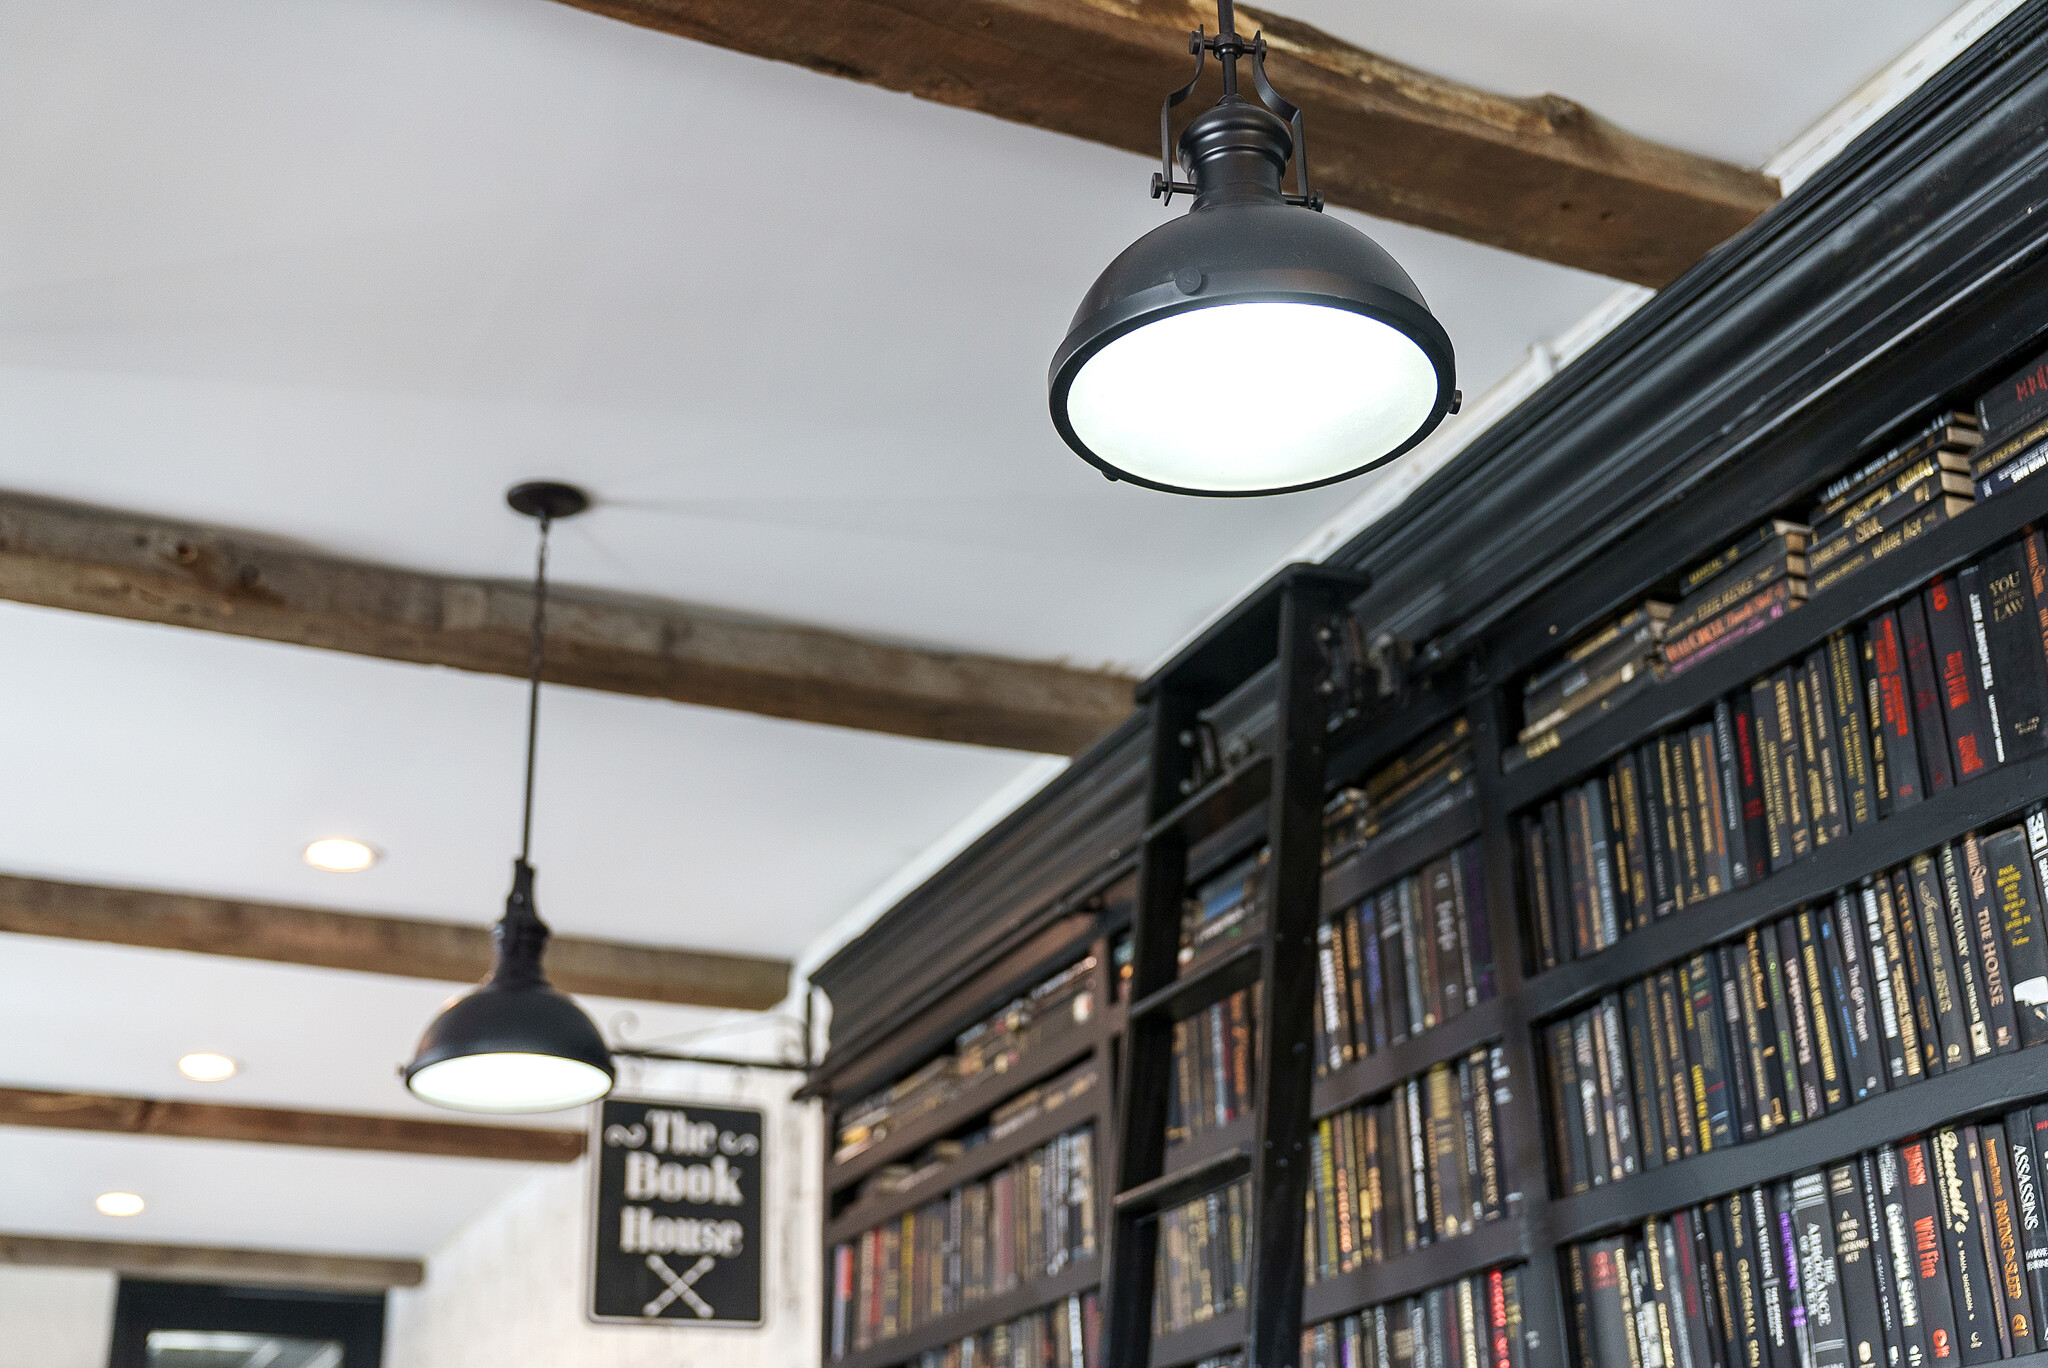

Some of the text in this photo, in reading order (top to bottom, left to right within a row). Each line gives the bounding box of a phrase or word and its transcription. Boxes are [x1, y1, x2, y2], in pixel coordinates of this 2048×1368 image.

[1989, 571, 2020, 597] YOU
[1993, 595, 2025, 623] LAW
[1973, 621, 1990, 665] MONEY
[1945, 875, 1970, 958] SANCTUARY
[1977, 905, 1994, 941] THE
[1933, 965, 1952, 1014] JESUS
[1981, 938, 2005, 1008] HOUSE
[645, 1110, 718, 1157] The
[624, 1151, 744, 1206] Book
[1939, 1131, 1971, 1234] Baseball's
[2012, 1143, 2039, 1231] ASSASSINS
[620, 1205, 744, 1259] House
[1914, 1215, 1939, 1279] Wild Fire
[1801, 1255, 1818, 1317] POWER
[1807, 1222, 1831, 1327] ARROGANCE
[1823, 1256, 1836, 1285] THE
[1958, 1249, 1975, 1312] PAUL DICKSON
[2004, 1262, 2022, 1300] SLEEP
